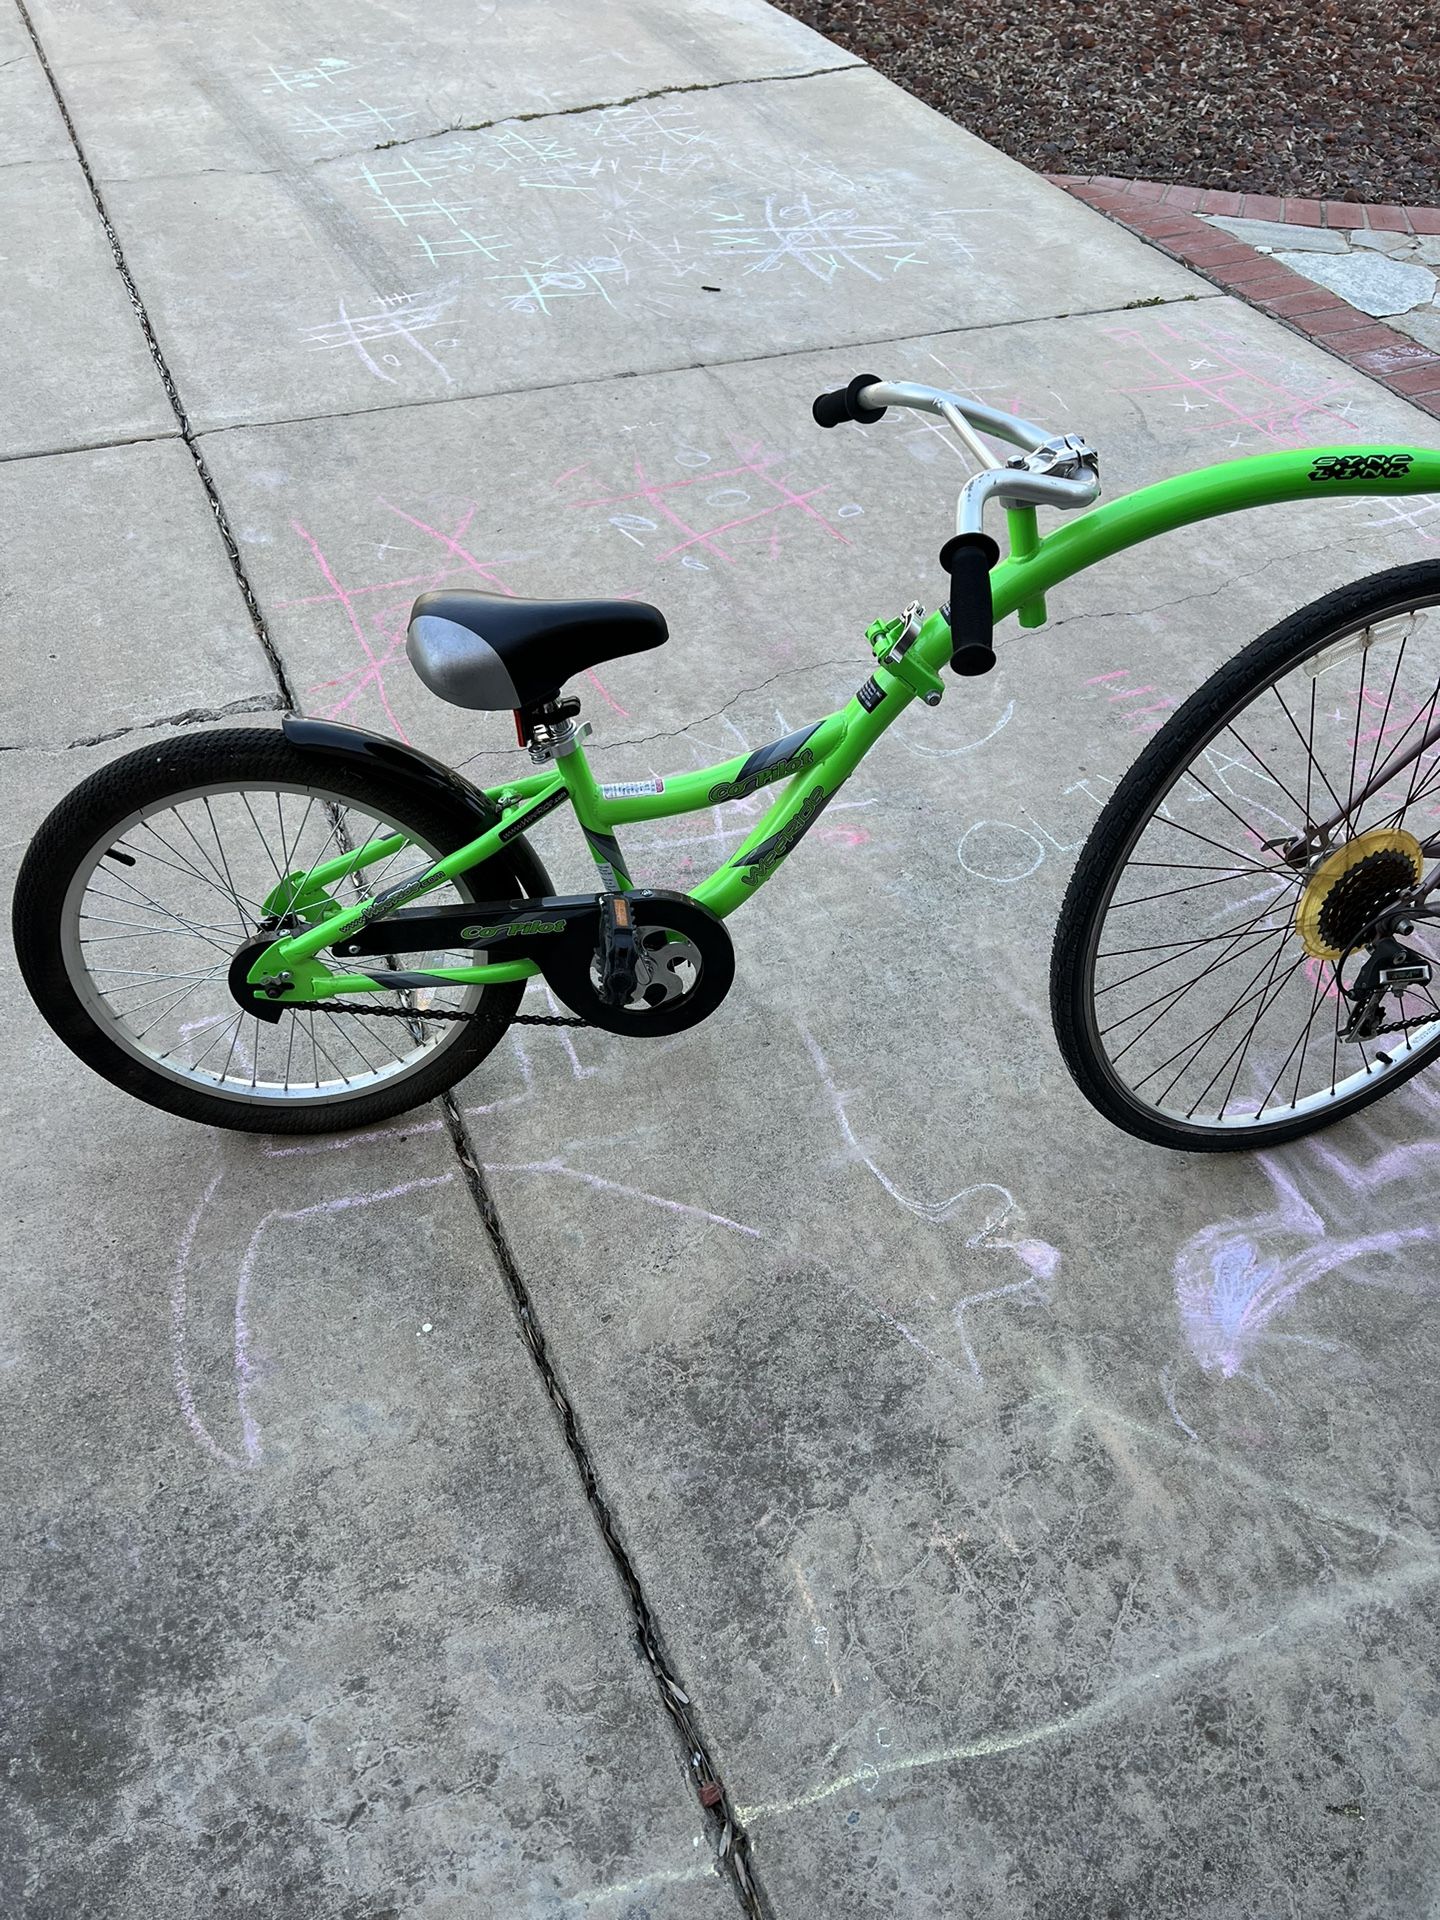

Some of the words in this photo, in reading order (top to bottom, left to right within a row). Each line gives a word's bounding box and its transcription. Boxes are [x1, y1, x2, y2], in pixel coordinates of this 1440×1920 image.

[1313, 454, 1413, 467] SYNC
[1309, 467, 1410, 480] LINK
[741, 785, 824, 887] WeeRide
